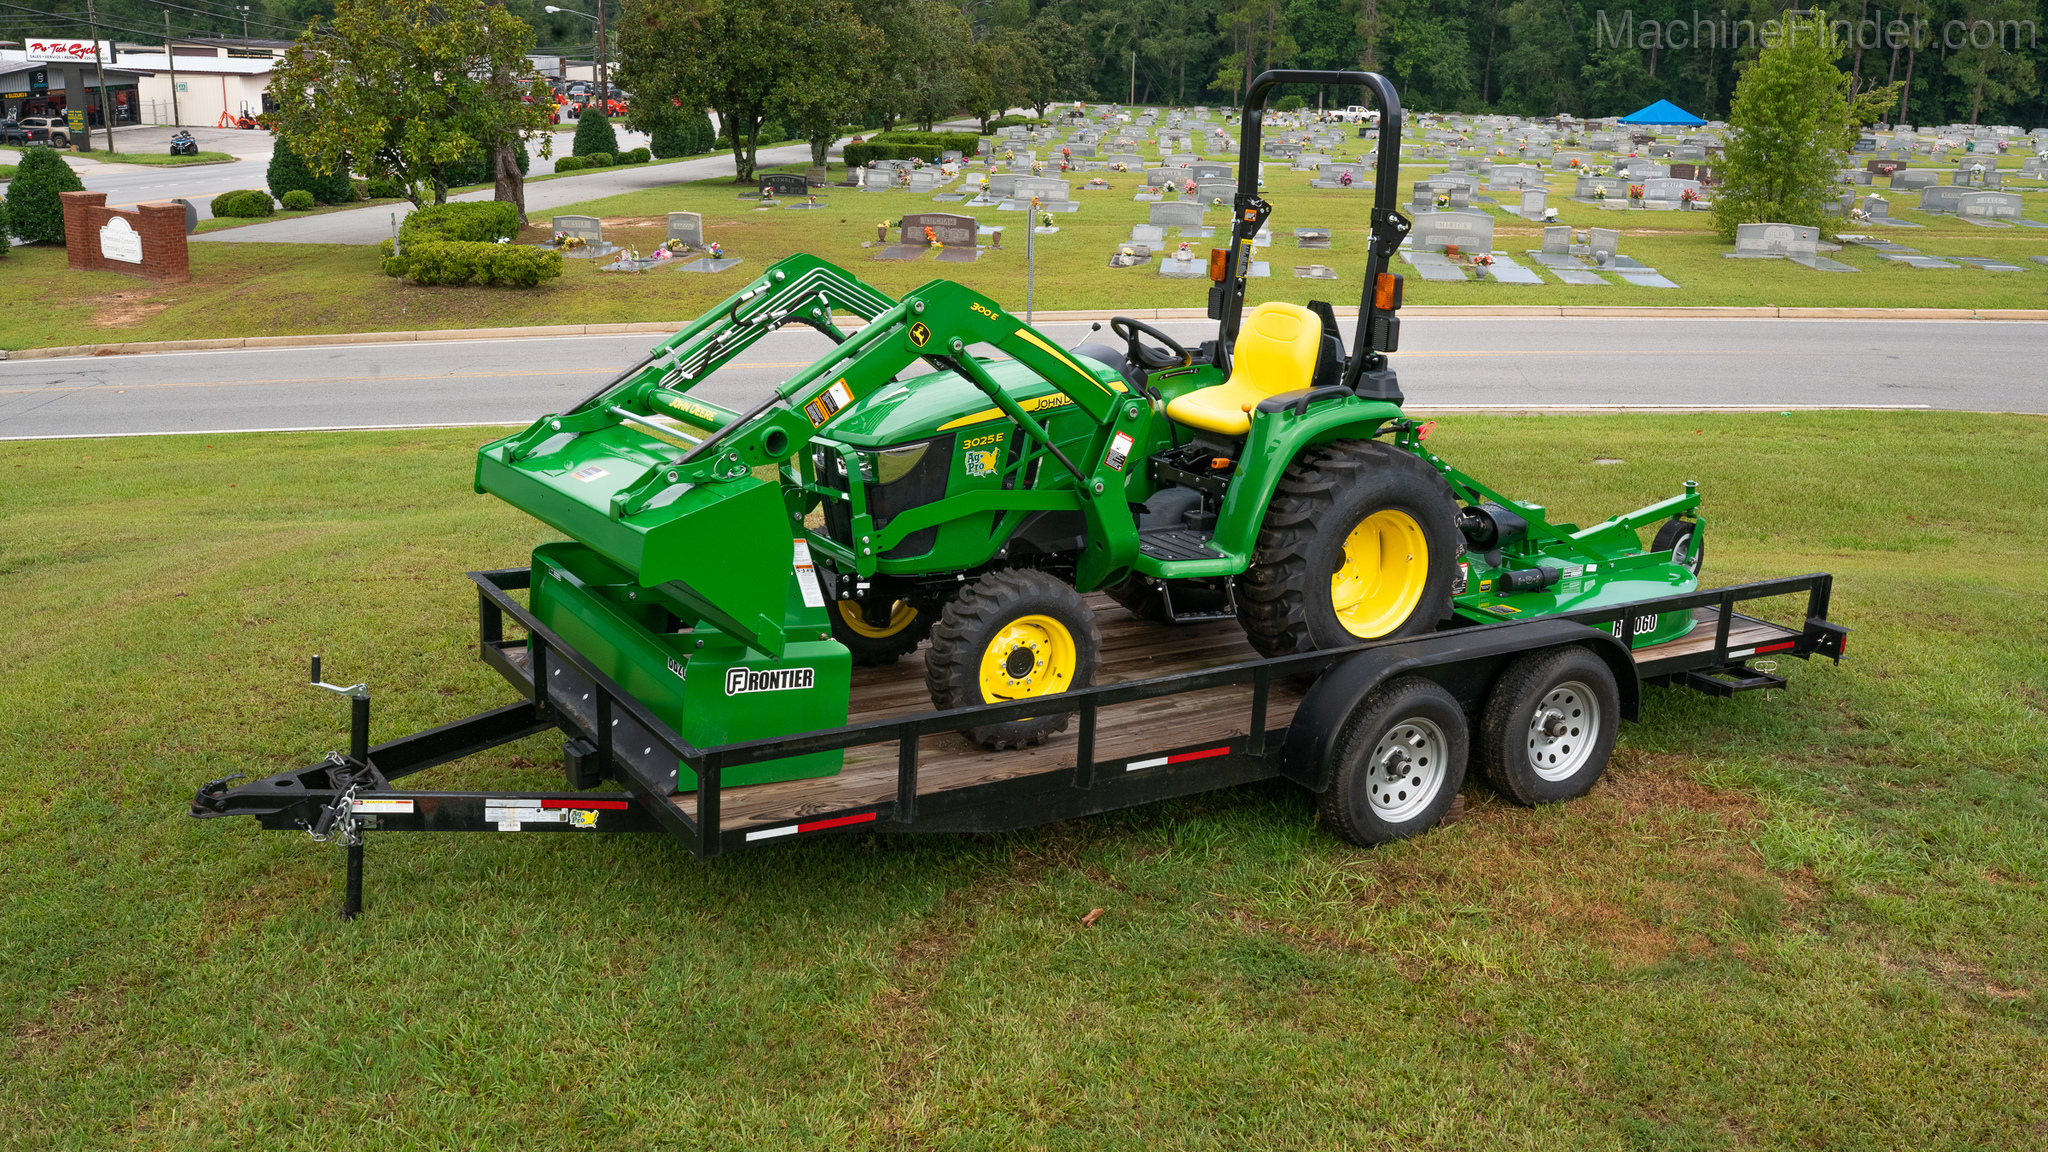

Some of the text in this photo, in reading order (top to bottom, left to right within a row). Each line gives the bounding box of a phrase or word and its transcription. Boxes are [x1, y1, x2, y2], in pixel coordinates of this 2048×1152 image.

[30, 43, 67, 54] Pro-Tech
[669, 397, 718, 422] JOHN DEERE
[1035, 397, 1063, 410] JOHN
[968, 462, 985, 473] Pro
[727, 668, 814, 694] FRONTIER
